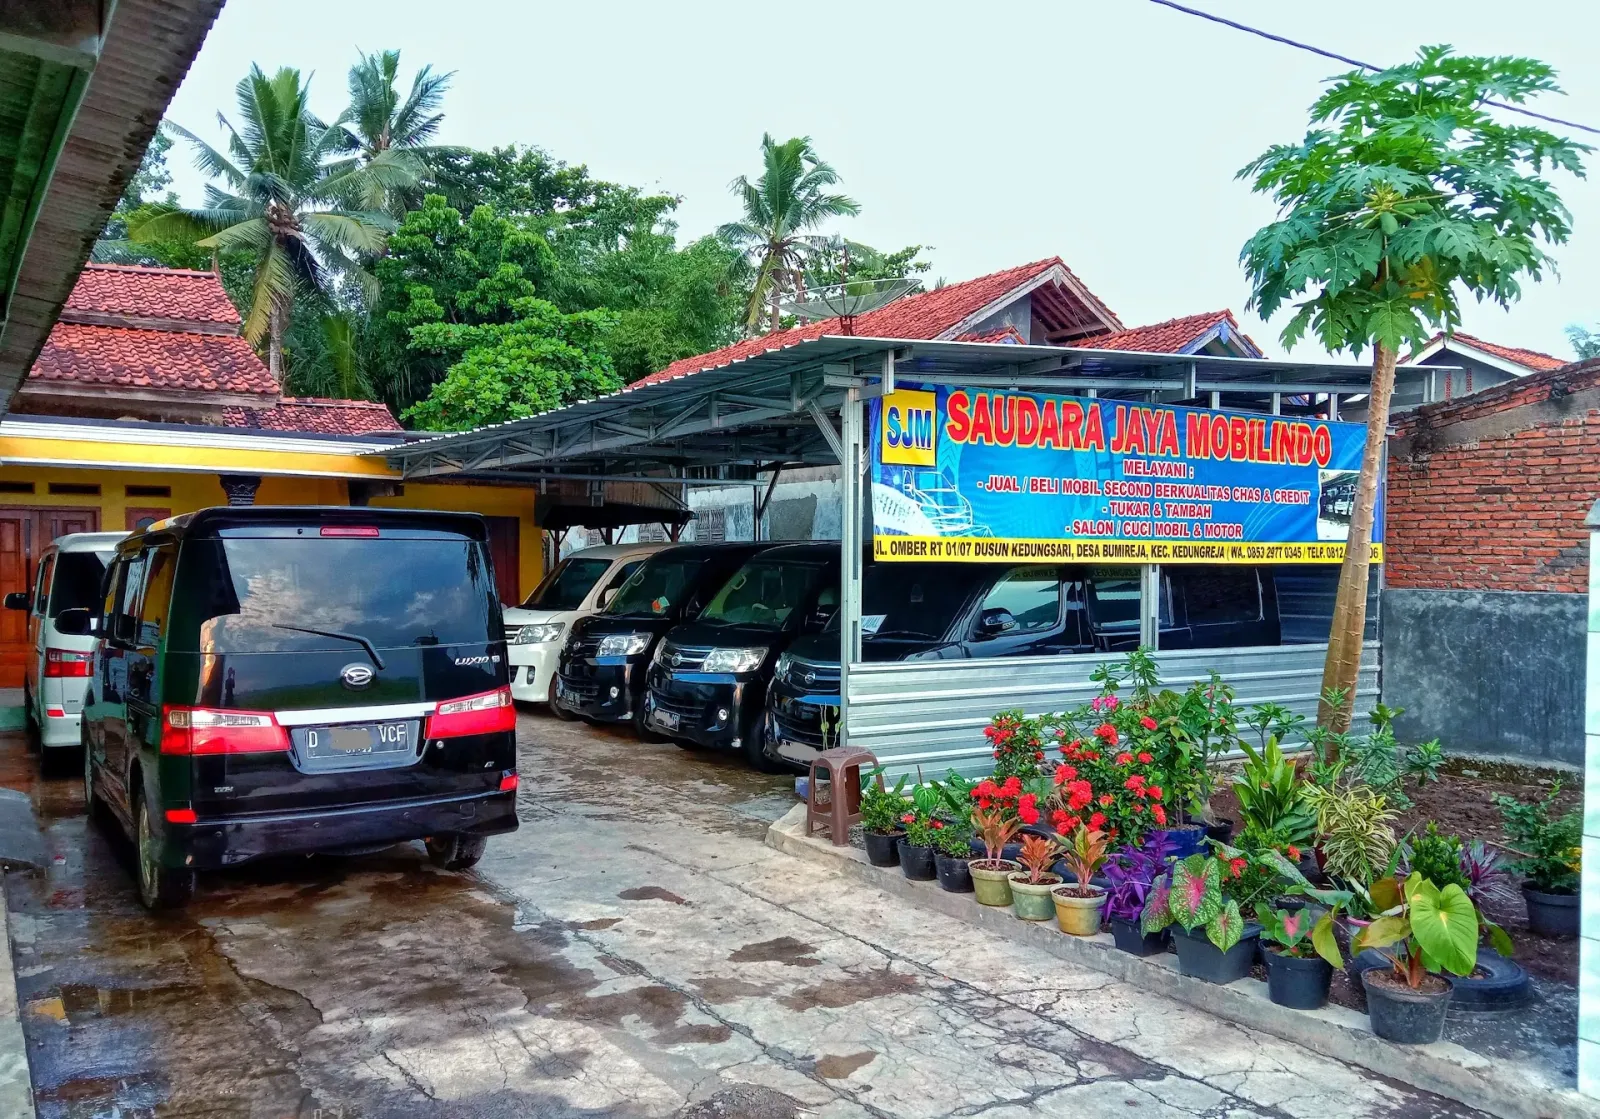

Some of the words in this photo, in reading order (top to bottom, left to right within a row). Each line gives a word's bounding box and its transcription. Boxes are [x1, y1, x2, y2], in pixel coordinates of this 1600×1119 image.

[887, 406, 932, 449] SJM
[946, 390, 1105, 452] SAUDARA
[1110, 405, 1180, 457] JAYA
[1186, 411, 1331, 468] MOBILINDO
[1123, 459, 1187, 478] MELAYANI
[985, 474, 1020, 493] JUAL
[1029, 476, 1059, 495] BELI
[1062, 478, 1101, 495] MOBIL
[1104, 481, 1152, 498] SECOND
[1155, 483, 1231, 500] BERKUALITAS
[1232, 486, 1261, 502] CHAS
[1273, 489, 1310, 504] CREDIT
[1109, 501, 1150, 517] TUKAR
[1152, 503, 1162, 518] &
[1165, 503, 1212, 519] TAMBAH
[1072, 520, 1114, 536] SALON
[1122, 521, 1152, 537] CUCI
[1154, 522, 1190, 538] MOBIL
[1193, 524, 1202, 538] &
[1204, 523, 1243, 539] MOTOR
[890, 541, 927, 556] OMBER
[930, 541, 943, 556] RT
[946, 542, 972, 557] 01/07
[974, 542, 1008, 557] DUSUN
[1011, 543, 1074, 560] KEDUNGSARI,
[1076, 543, 1100, 558] DESA
[1102, 544, 1149, 560] BUMIREJA,
[1151, 545, 1171, 559] KEC.
[1172, 545, 1225, 559] KEDUNGREJA
[1247, 546, 1265, 559] 0853
[1326, 546, 1344, 559] 0812
[308, 731, 318, 748] D
[379, 725, 406, 743] VCF
